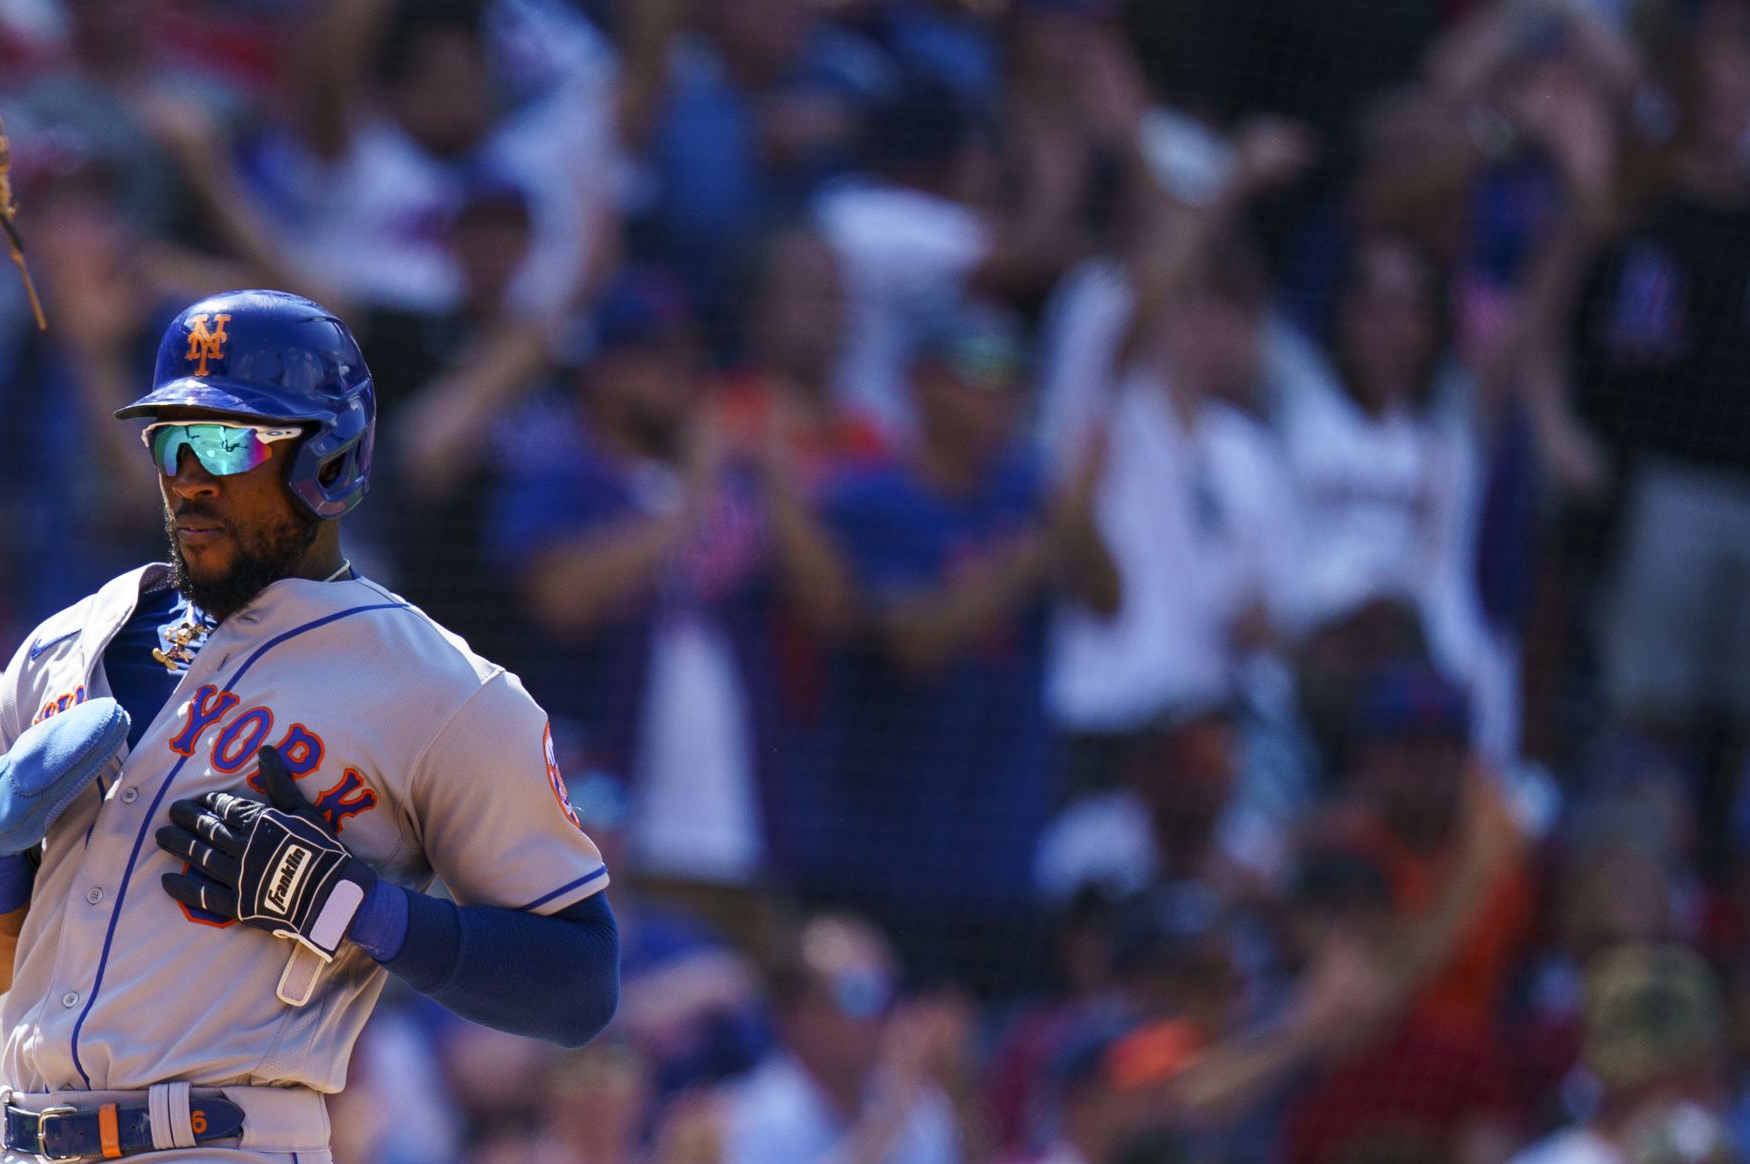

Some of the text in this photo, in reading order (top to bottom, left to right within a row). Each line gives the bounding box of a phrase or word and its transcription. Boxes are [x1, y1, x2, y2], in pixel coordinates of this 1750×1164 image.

[169, 684, 378, 833] YORK
[266, 847, 307, 911] Franklin
[191, 1110, 207, 1134] 6
